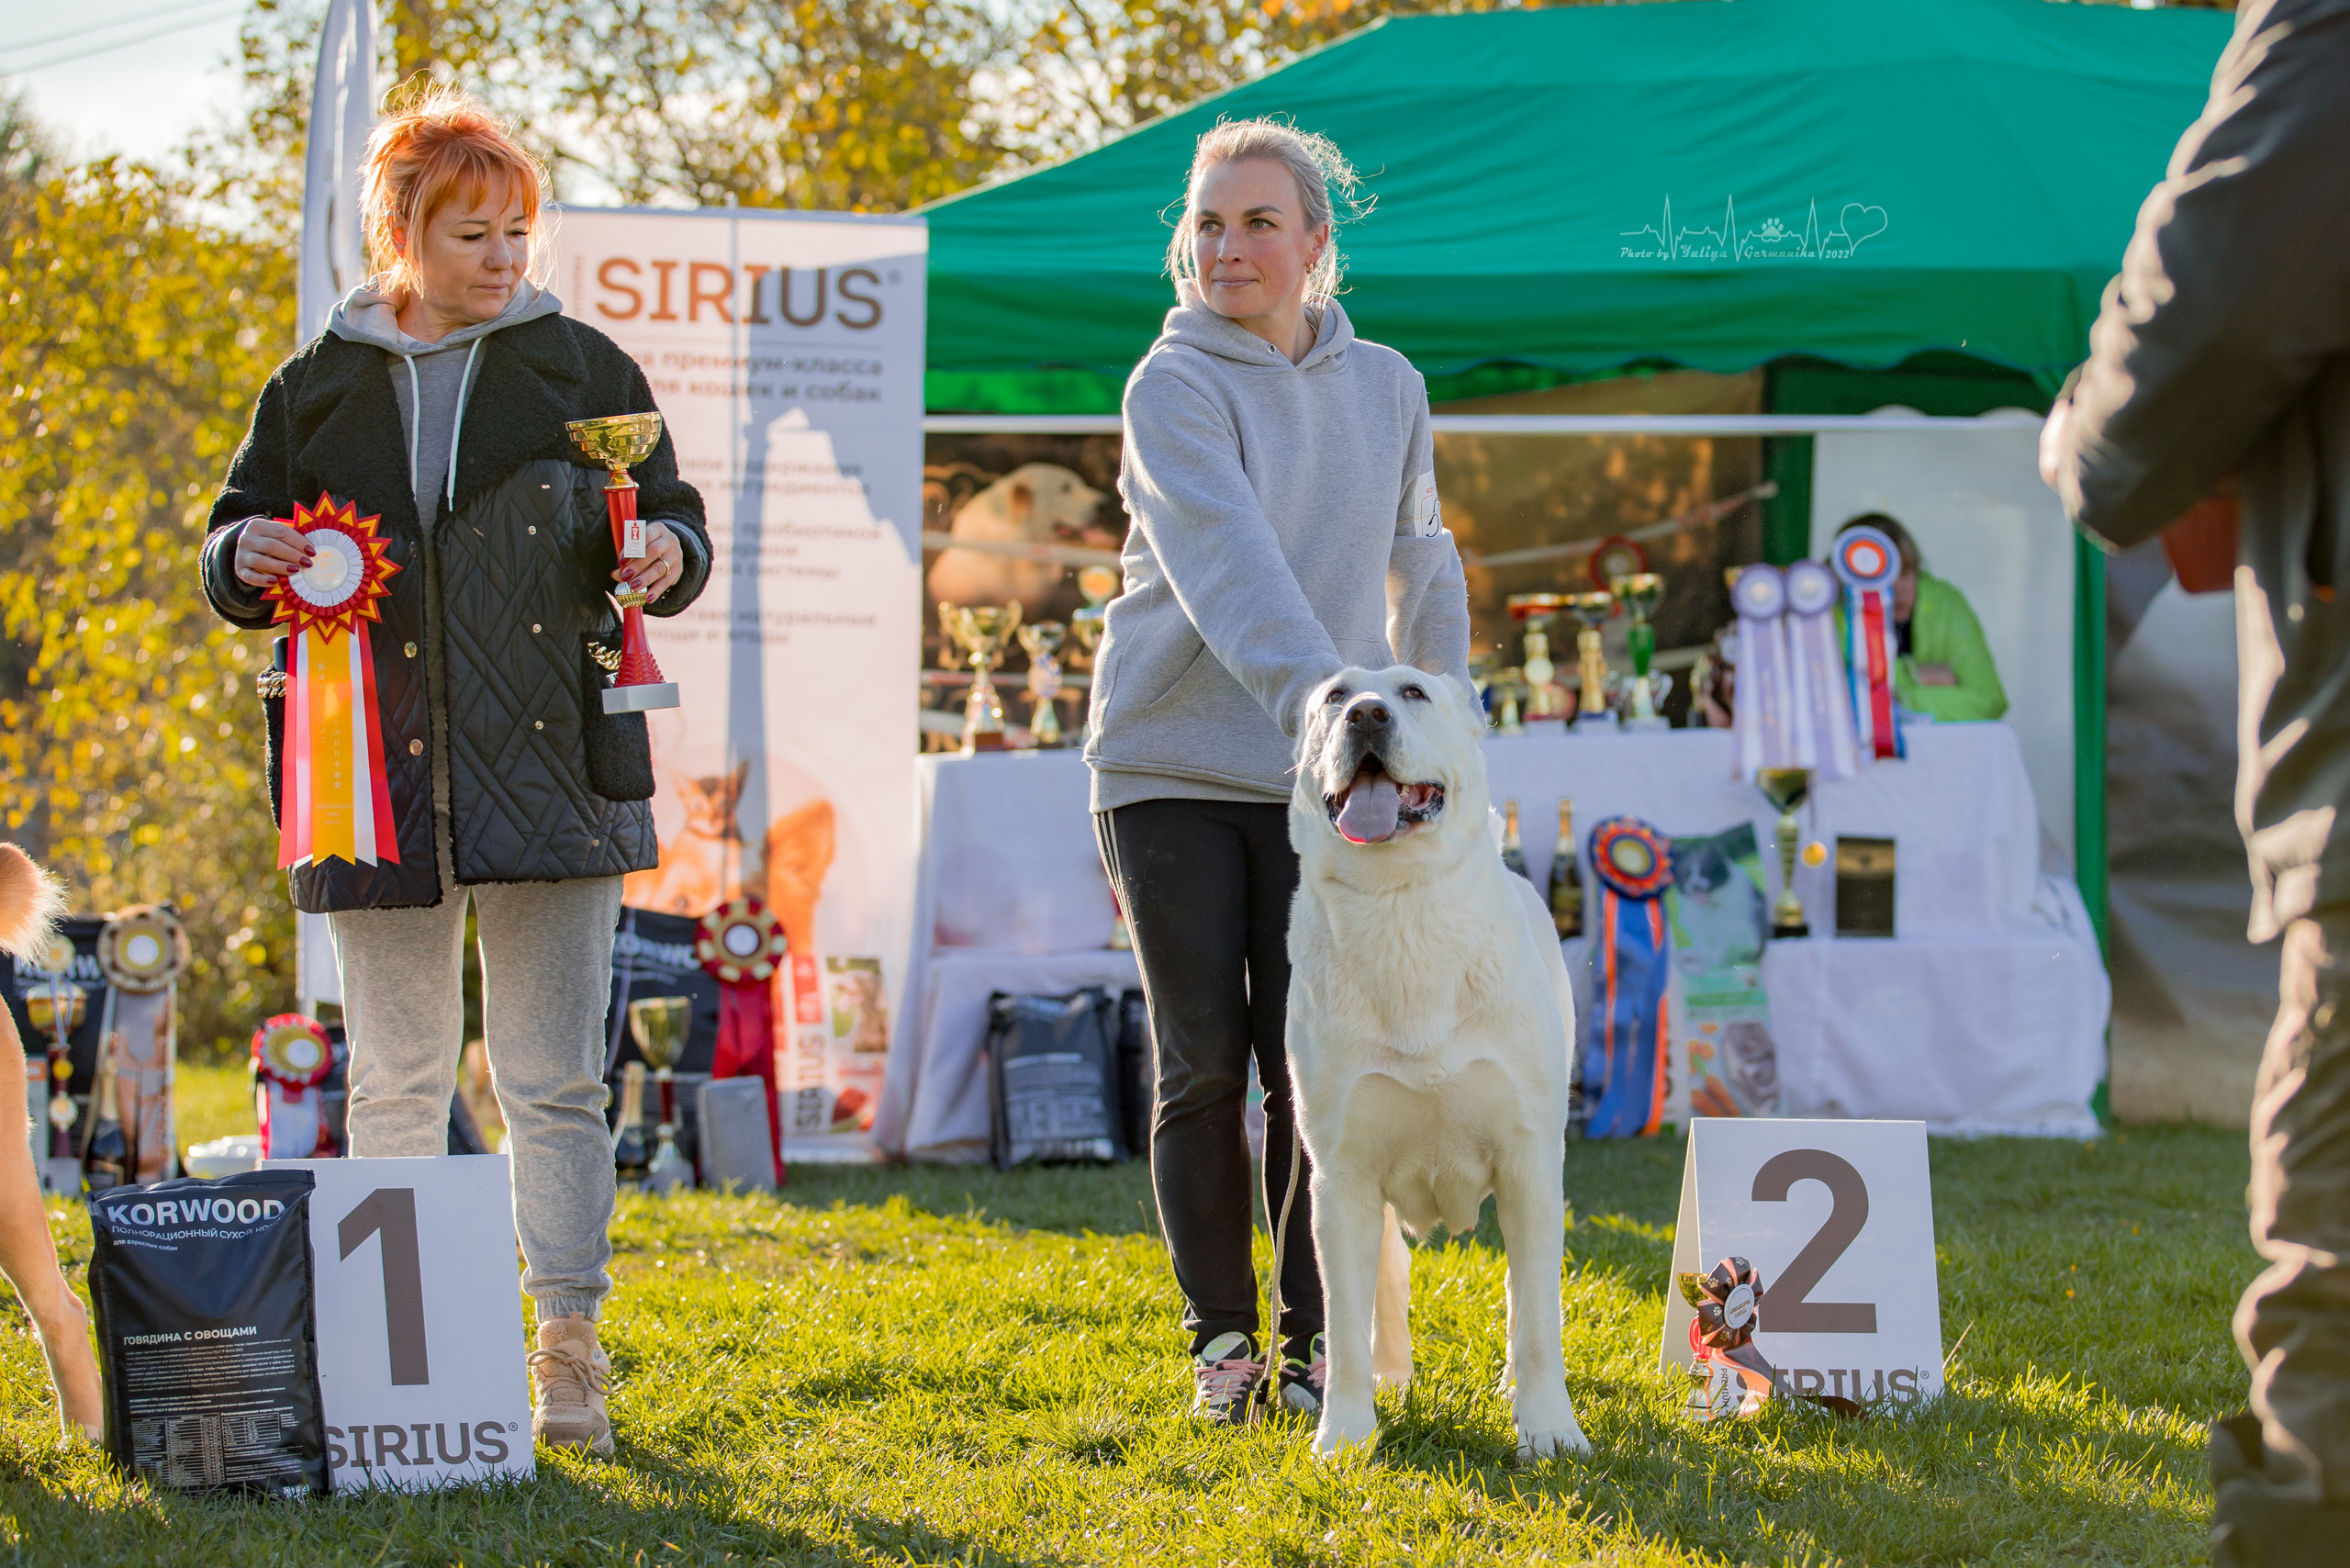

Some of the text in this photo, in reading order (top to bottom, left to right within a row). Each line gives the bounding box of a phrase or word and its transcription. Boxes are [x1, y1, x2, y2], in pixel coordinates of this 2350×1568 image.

[653, 380, 681, 394] ля
[106, 1198, 285, 1226] KORWOOD
[112, 1225, 218, 1242] ПОЛНОРАЦИОННЫЙ
[219, 1227, 254, 1240] СУХОЙ
[1751, 1148, 1877, 1333] 2
[127, 1239, 158, 1249] взрослых
[159, 1244, 179, 1252] собак
[337, 1187, 430, 1386] 1
[123, 1326, 257, 1346] ГОВЯДИНА С ОВОЩАМИ
